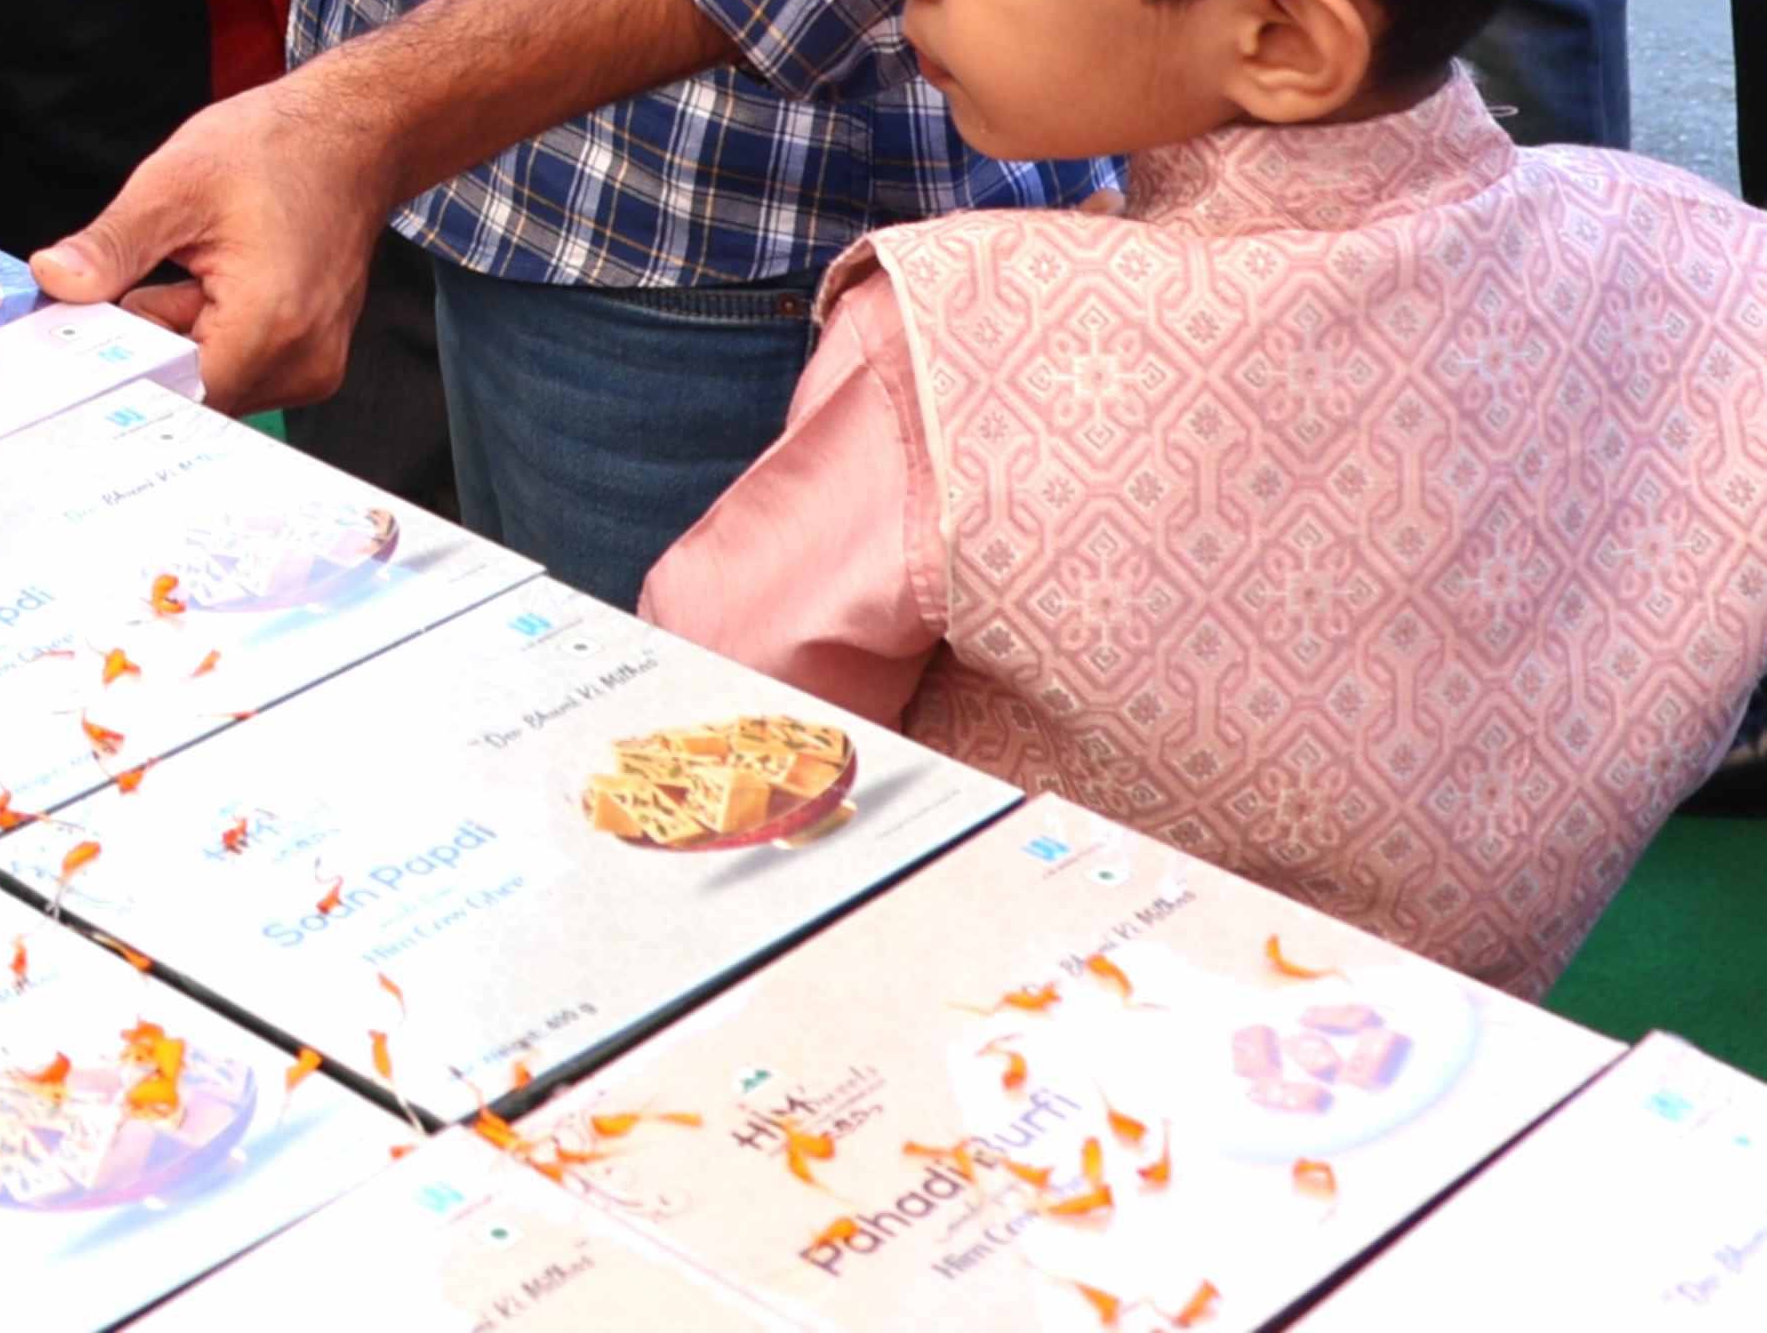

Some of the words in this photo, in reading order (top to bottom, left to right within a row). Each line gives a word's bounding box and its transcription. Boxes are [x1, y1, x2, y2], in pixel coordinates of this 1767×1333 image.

[260, 884, 381, 950] Soan
[369, 818, 499, 890] Papdi
[965, 1087, 1082, 1171] Burfi
[931, 1233, 994, 1280] Him
